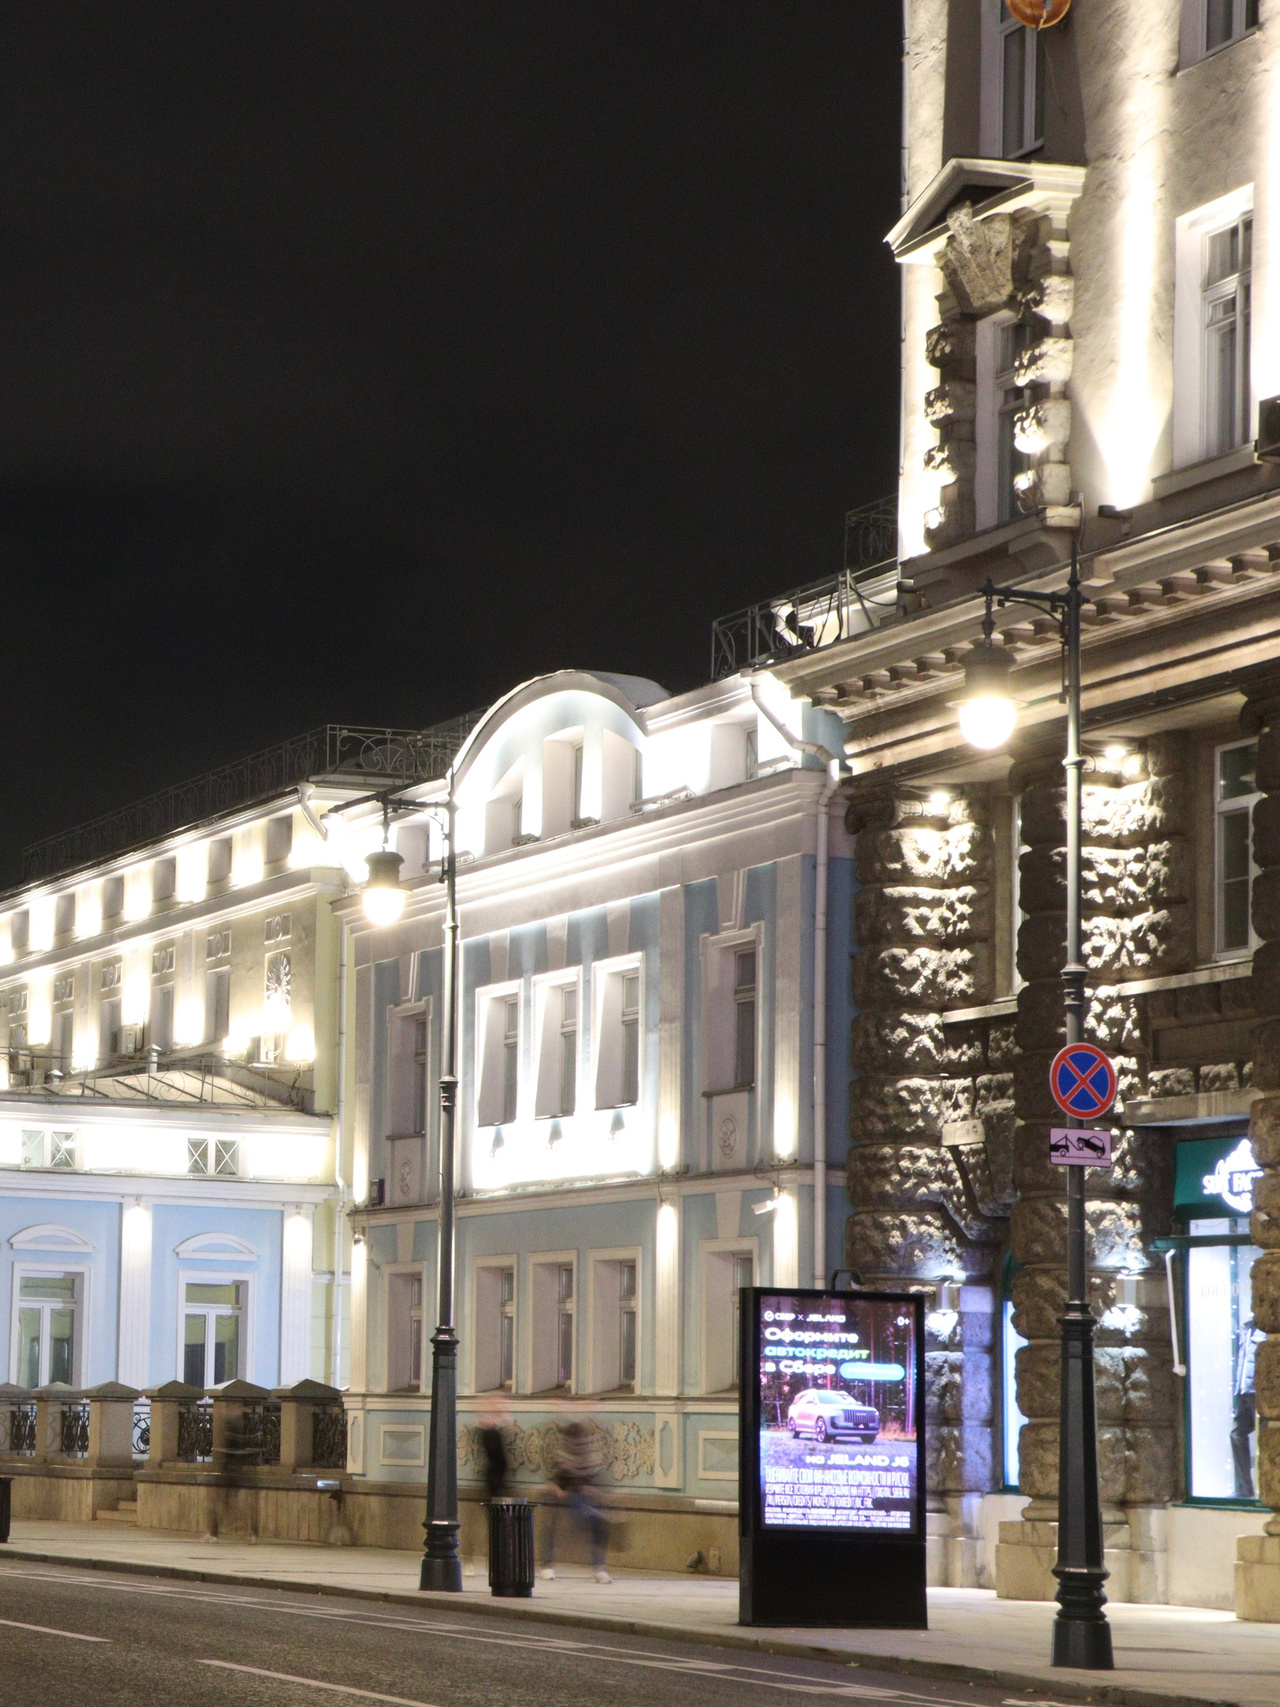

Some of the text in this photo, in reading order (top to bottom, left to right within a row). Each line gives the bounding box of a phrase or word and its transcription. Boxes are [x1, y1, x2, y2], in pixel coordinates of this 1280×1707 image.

[764, 1327, 859, 1343] Оформите
[764, 1346, 870, 1360] автокредит
[765, 1362, 776, 1372] в
[779, 1360, 836, 1376] Сбере
[805, 1455, 825, 1464] на
[827, 1454, 890, 1466] JELAND
